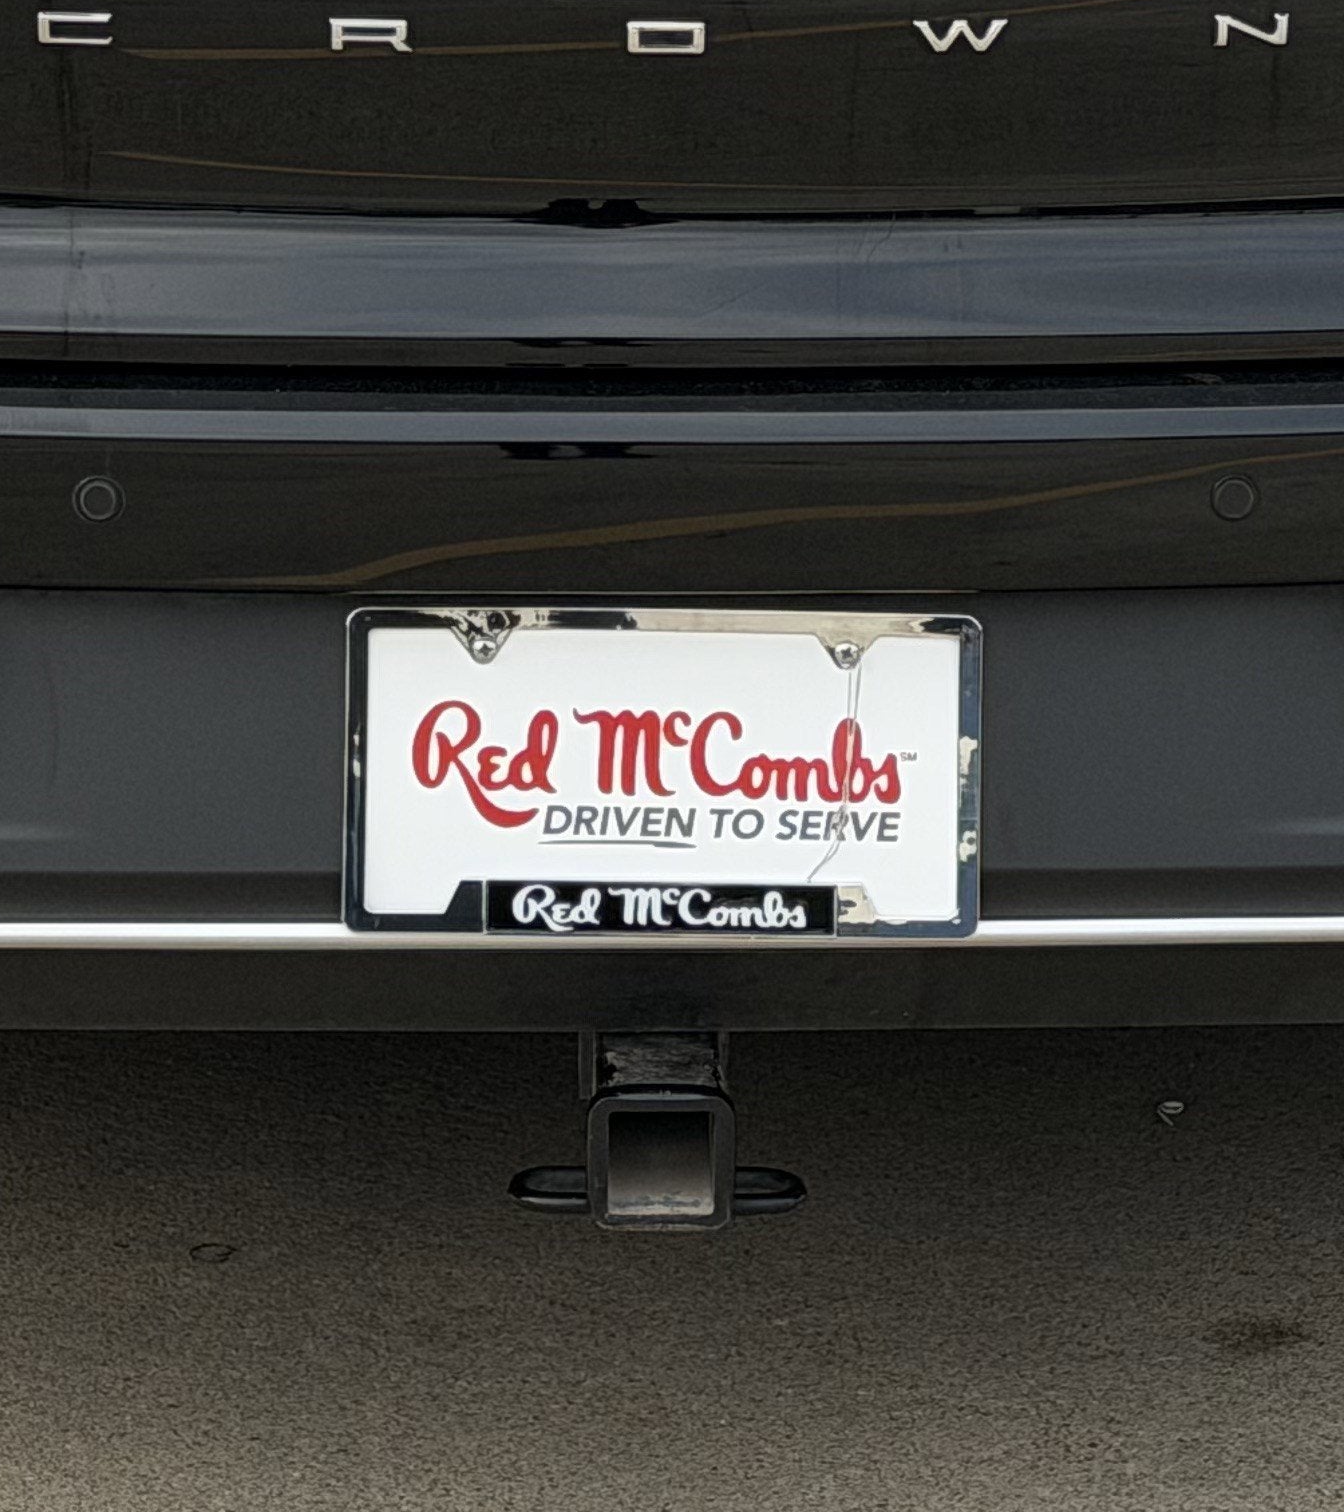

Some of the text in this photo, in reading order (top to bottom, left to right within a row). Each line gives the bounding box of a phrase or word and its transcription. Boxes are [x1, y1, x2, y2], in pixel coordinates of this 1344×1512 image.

[37, 11, 1290, 54] CROWN
[413, 701, 558, 827] Red
[574, 708, 902, 804] McCombs
[543, 805, 901, 842] DRIVEN TO SERVE
[512, 884, 808, 931] Red McCombs
